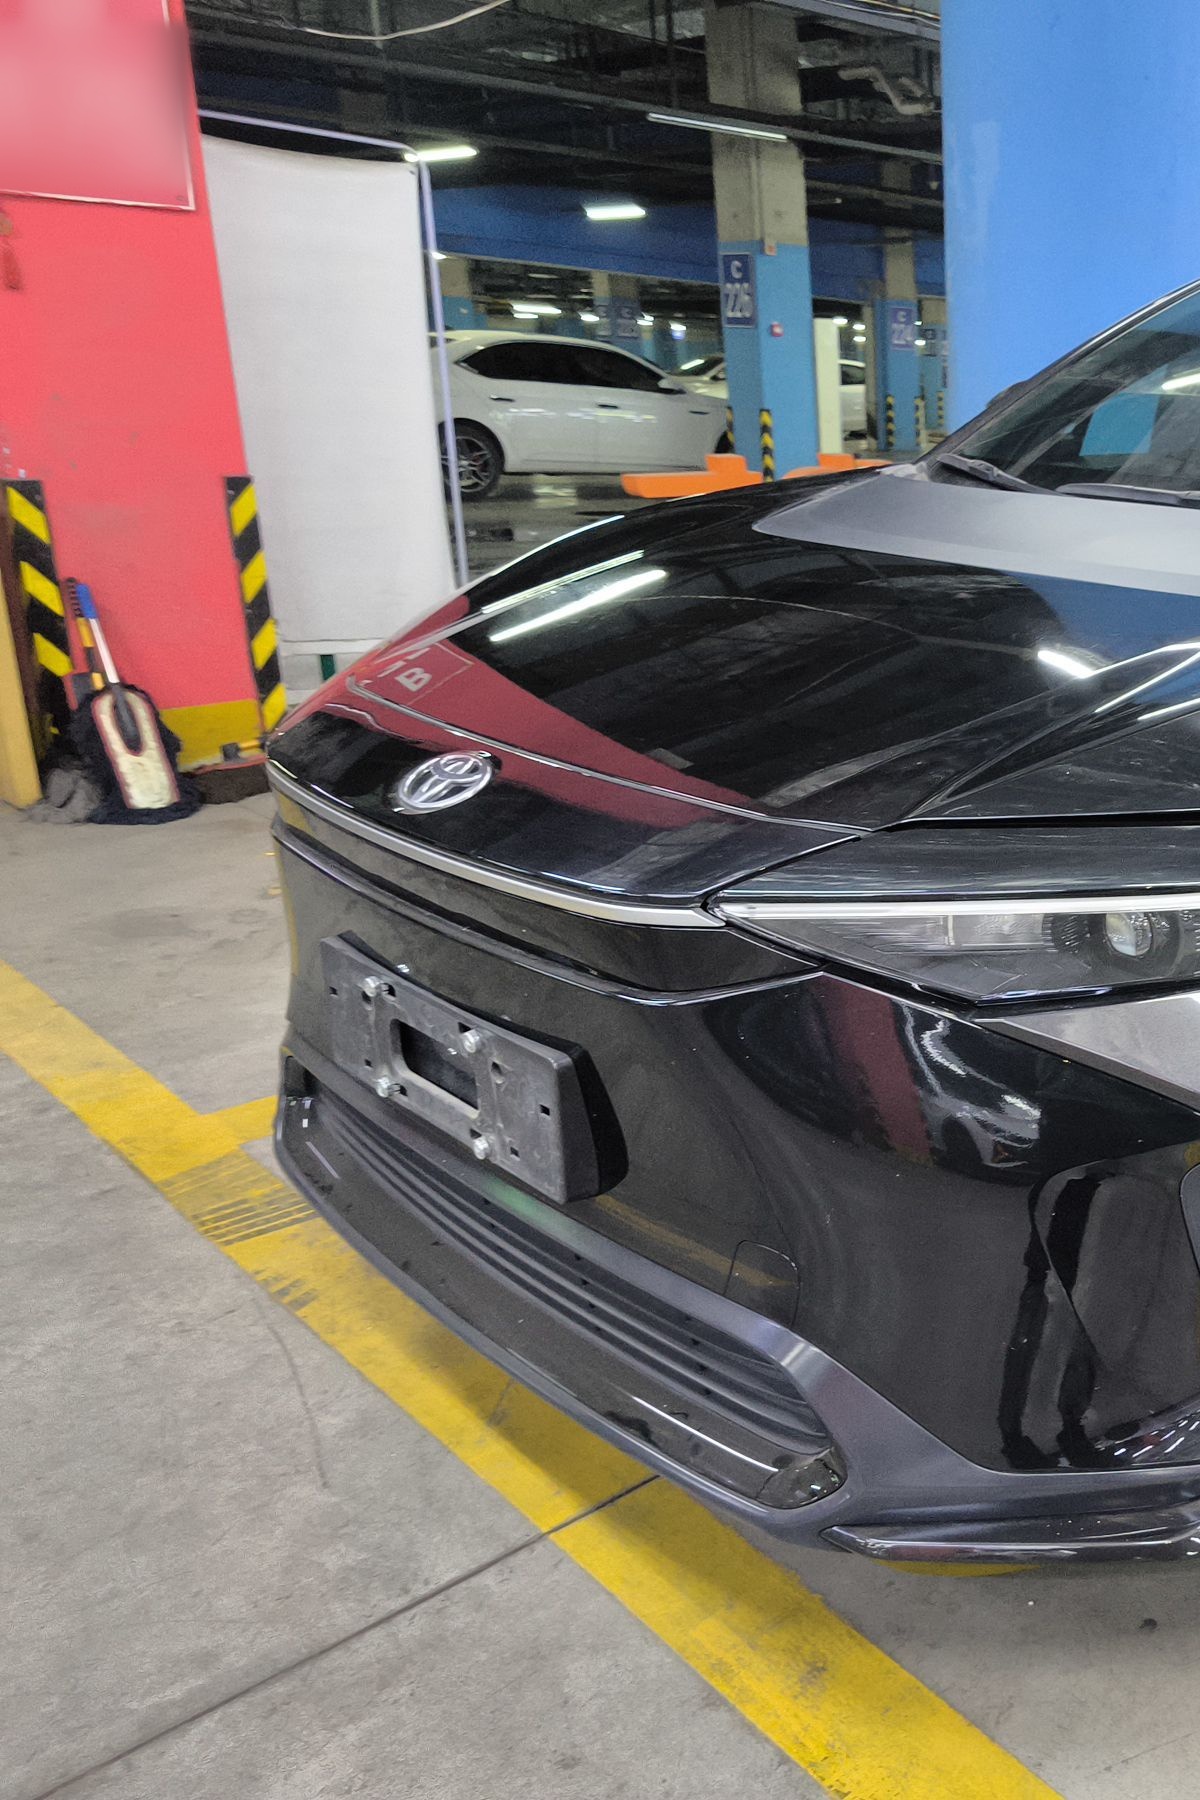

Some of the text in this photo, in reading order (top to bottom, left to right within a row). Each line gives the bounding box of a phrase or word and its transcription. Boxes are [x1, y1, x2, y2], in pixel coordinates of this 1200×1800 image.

[730, 260, 743, 279] C
[724, 283, 753, 318] 226
[896, 311, 907, 322] C
